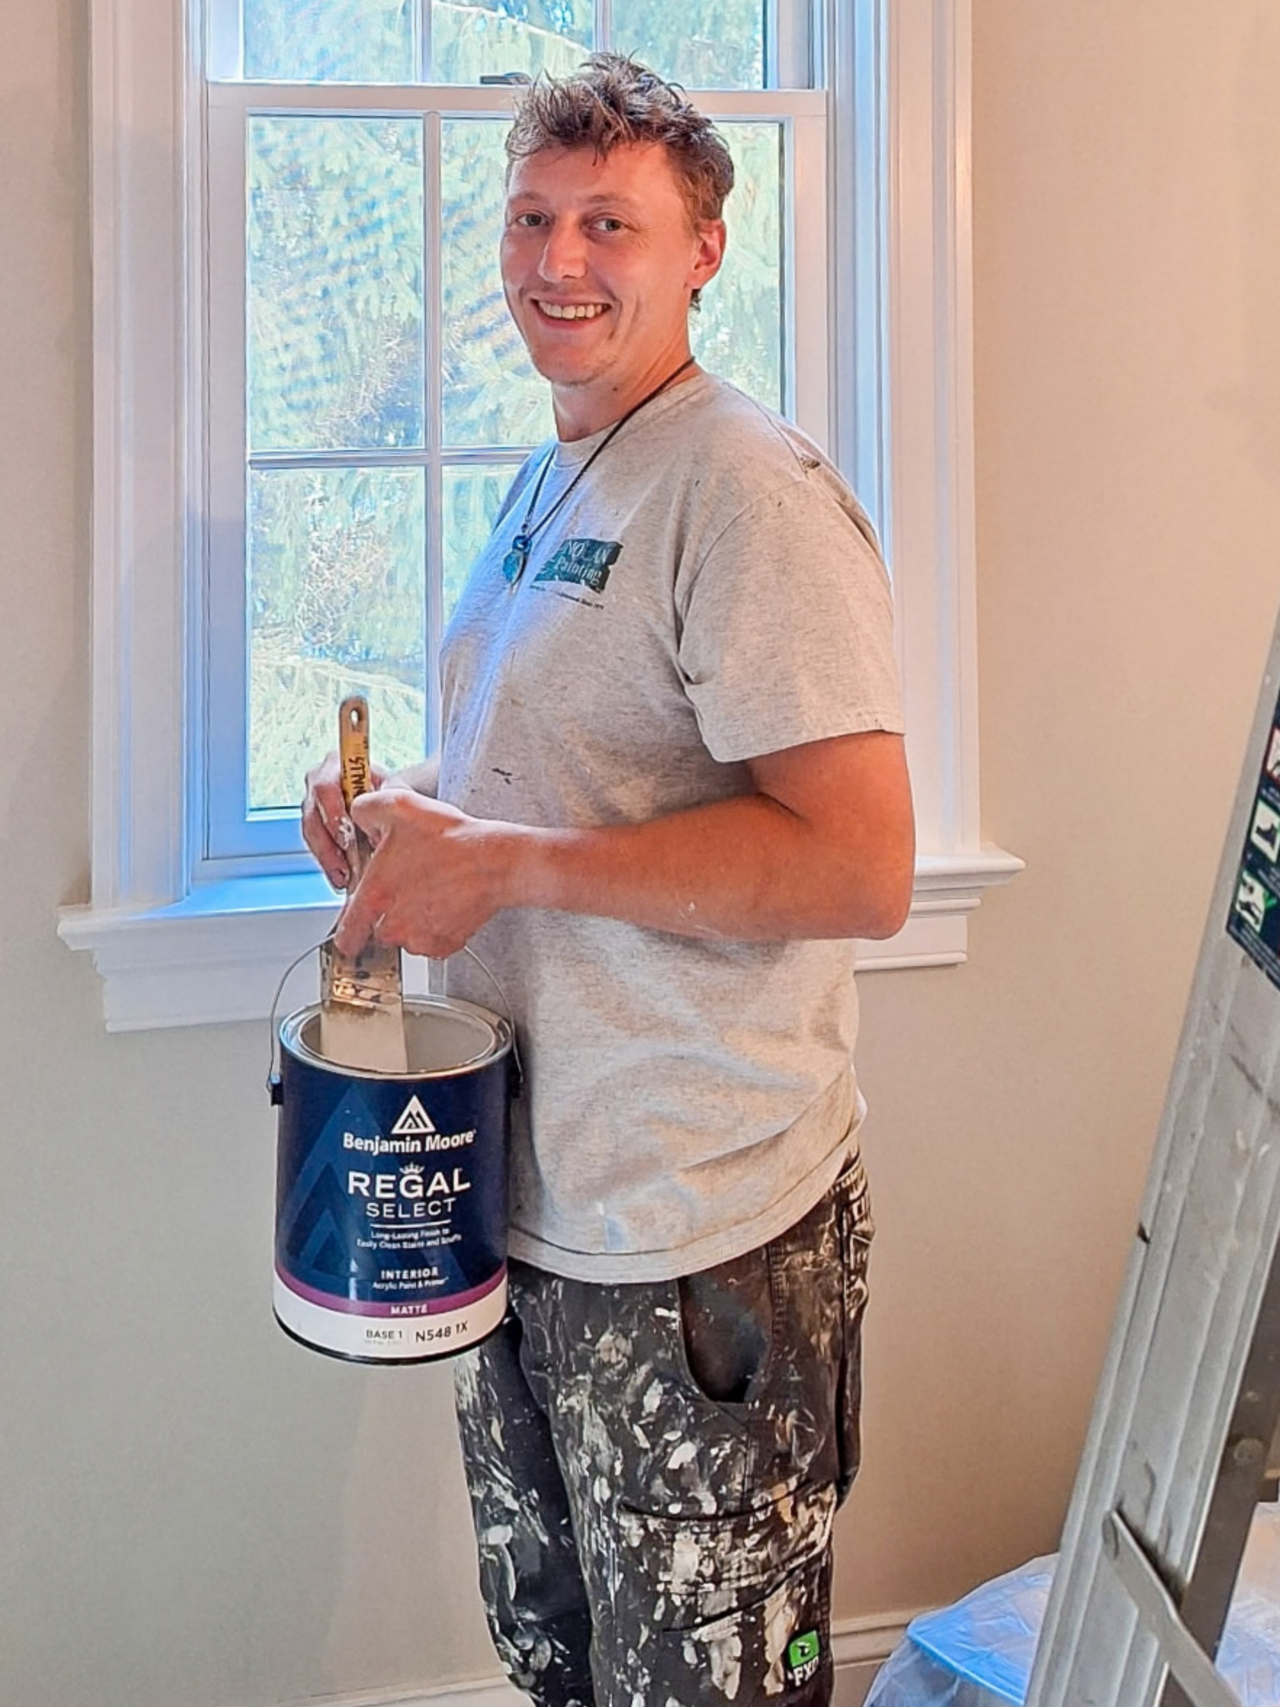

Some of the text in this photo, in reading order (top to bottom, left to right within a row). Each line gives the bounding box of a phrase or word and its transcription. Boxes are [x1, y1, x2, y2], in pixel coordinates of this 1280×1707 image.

[343, 1130, 475, 1156] Benjamin Moore
[348, 1168, 471, 1199] REGAL
[366, 1198, 457, 1218] SELECT
[426, 1238, 440, 1247] and
[380, 1266, 439, 1280] INTERIOR
[390, 1303, 428, 1315] MATTE
[366, 1329, 395, 1339] BASE
[415, 1325, 452, 1343] N548
